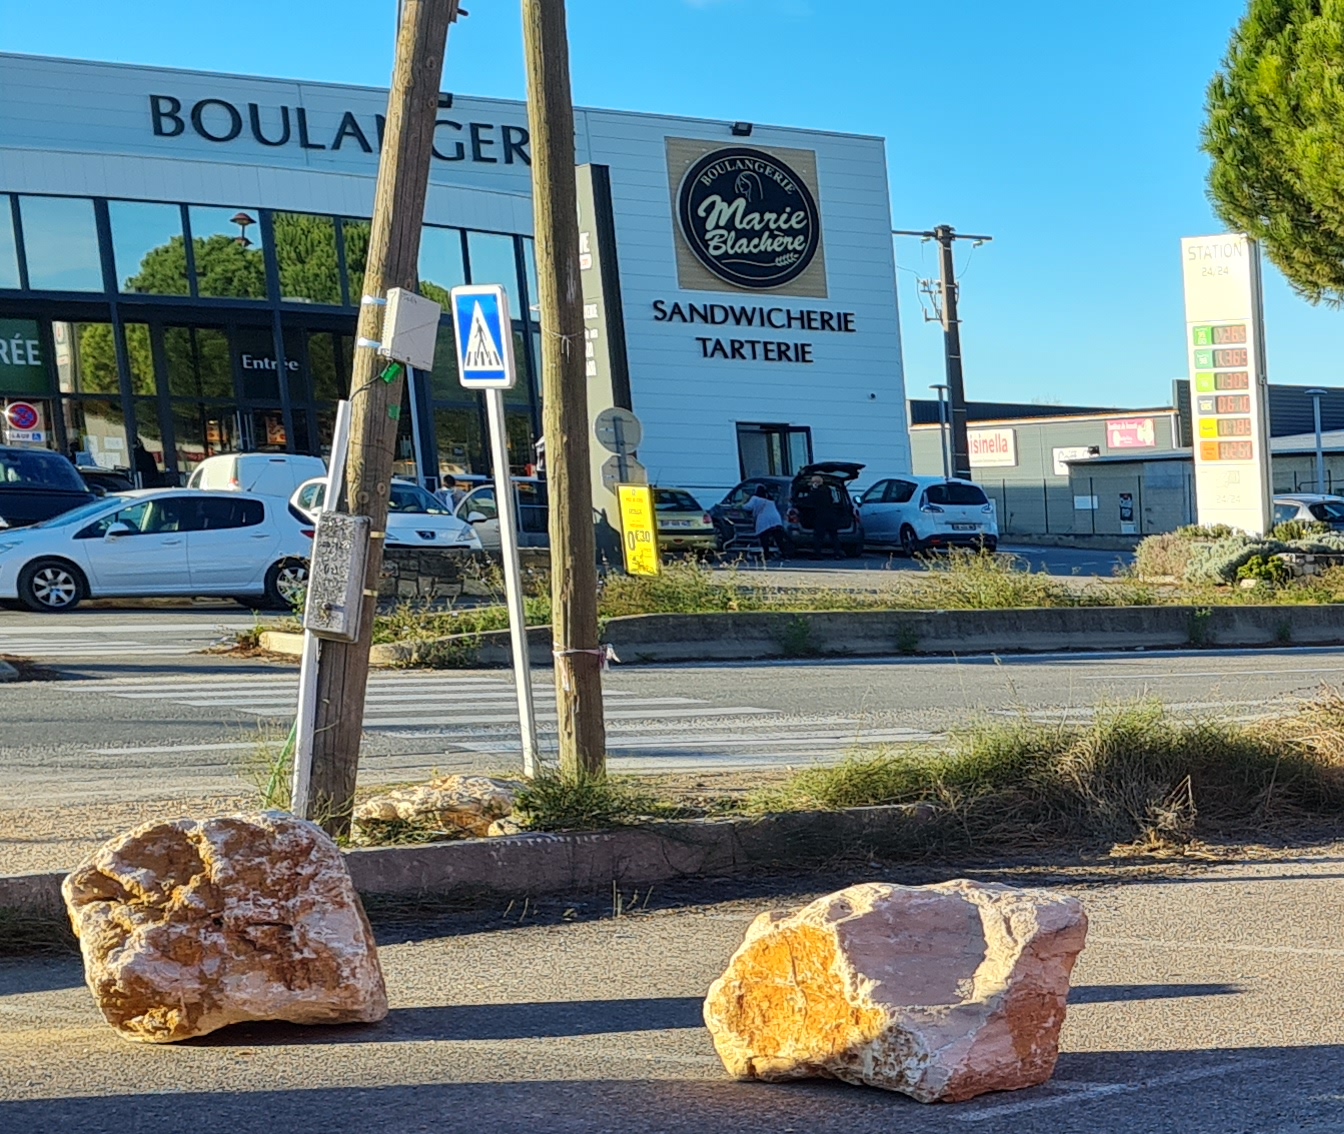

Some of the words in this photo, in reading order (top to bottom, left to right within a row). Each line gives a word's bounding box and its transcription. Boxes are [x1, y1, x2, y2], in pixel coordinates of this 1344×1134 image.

[149, 94, 575, 165] BOULAGER
[700, 158, 796, 195] BOULANGERIE
[697, 194, 807, 231] Marie
[704, 229, 806, 256] Blachère
[1187, 241, 1242, 261] STATION
[1201, 265, 1229, 277] 24/24
[653, 300, 856, 332] SANDWICHERIE
[695, 336, 814, 363] TARTERIE
